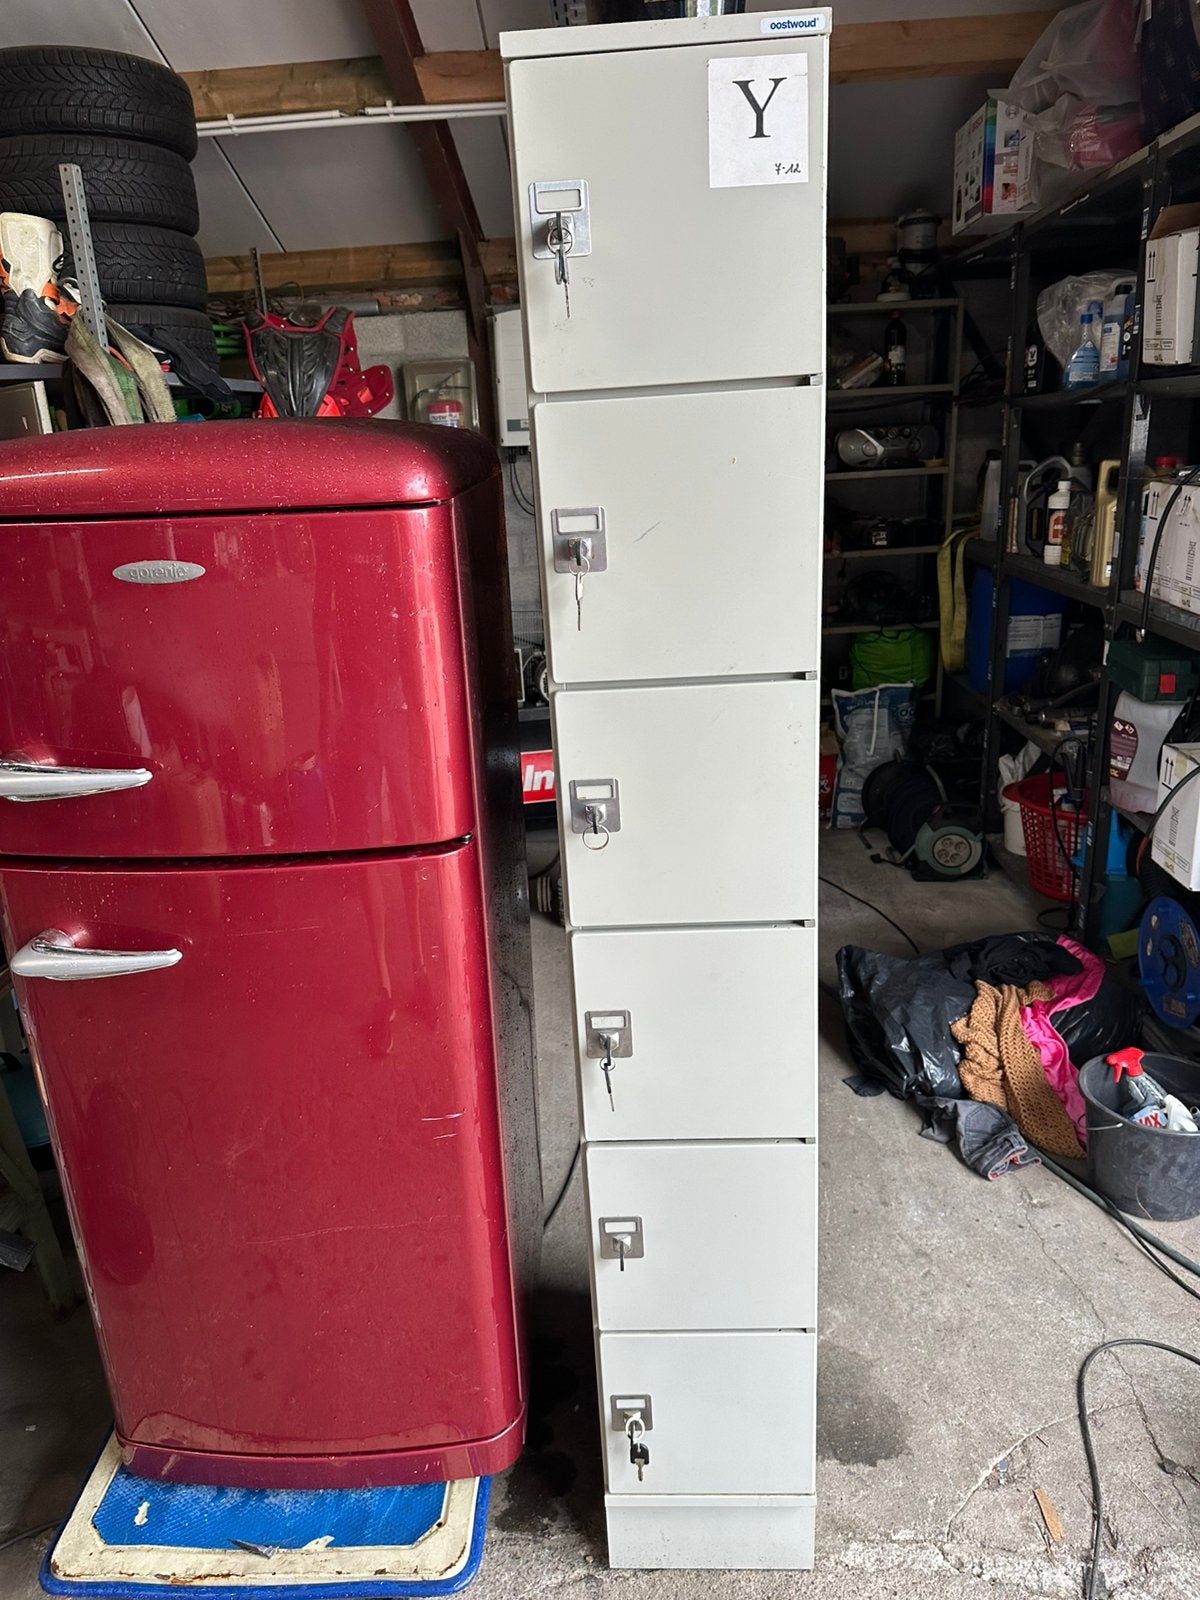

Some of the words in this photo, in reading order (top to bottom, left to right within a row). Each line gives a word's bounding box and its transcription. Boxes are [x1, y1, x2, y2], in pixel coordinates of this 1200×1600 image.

[769, 18, 816, 30] oostwoud
[732, 76, 787, 139] Y
[129, 563, 187, 580] gorenje
